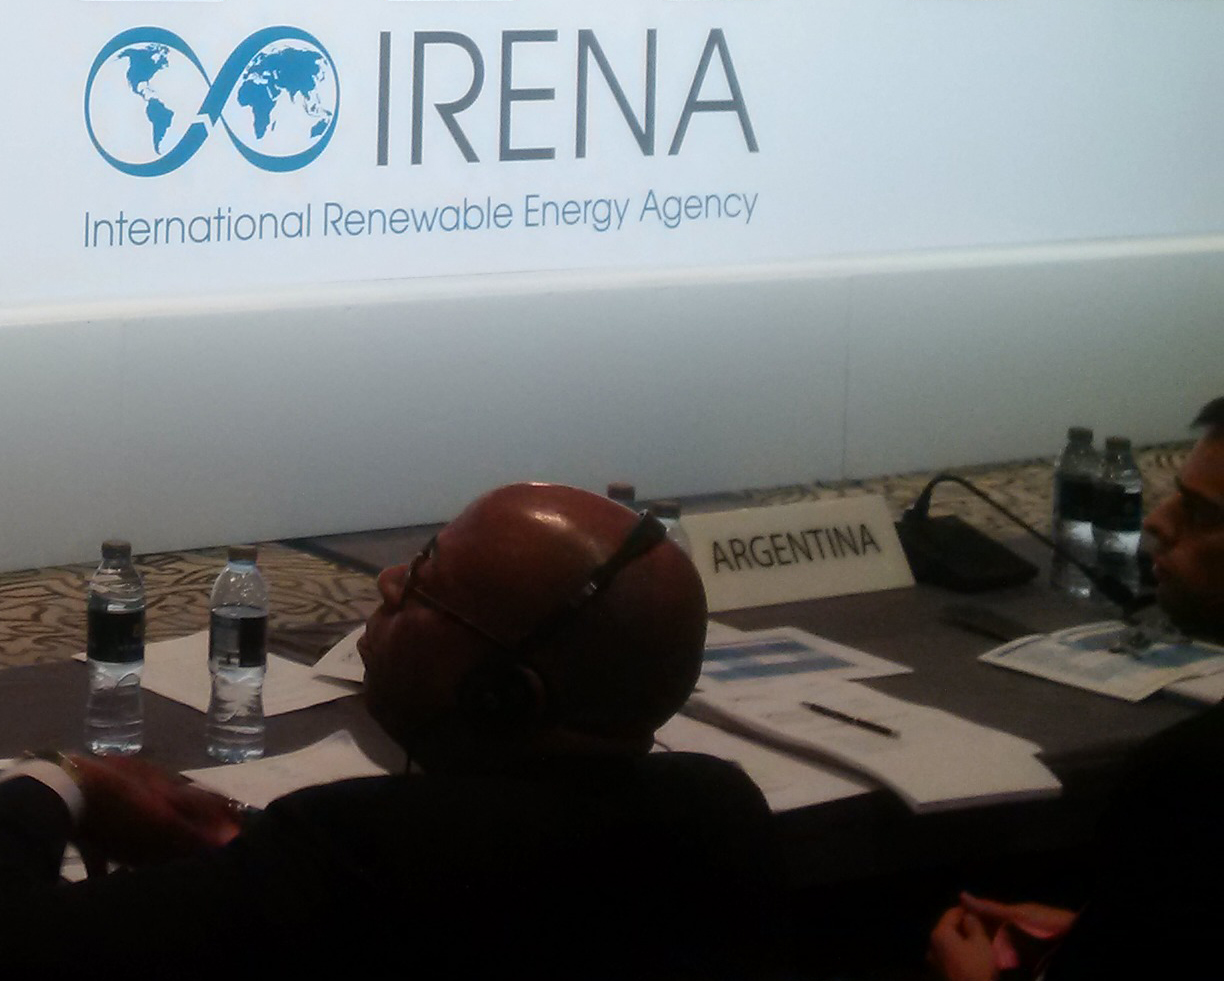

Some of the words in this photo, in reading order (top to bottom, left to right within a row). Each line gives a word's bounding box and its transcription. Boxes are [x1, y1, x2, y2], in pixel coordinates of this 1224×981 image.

[376, 27, 760, 168] IRENA
[83, 202, 313, 249] International
[323, 195, 514, 238] Renewable
[523, 193, 631, 233] Energy
[639, 188, 760, 230] Agency
[711, 523, 881, 574] ARGENTINA
